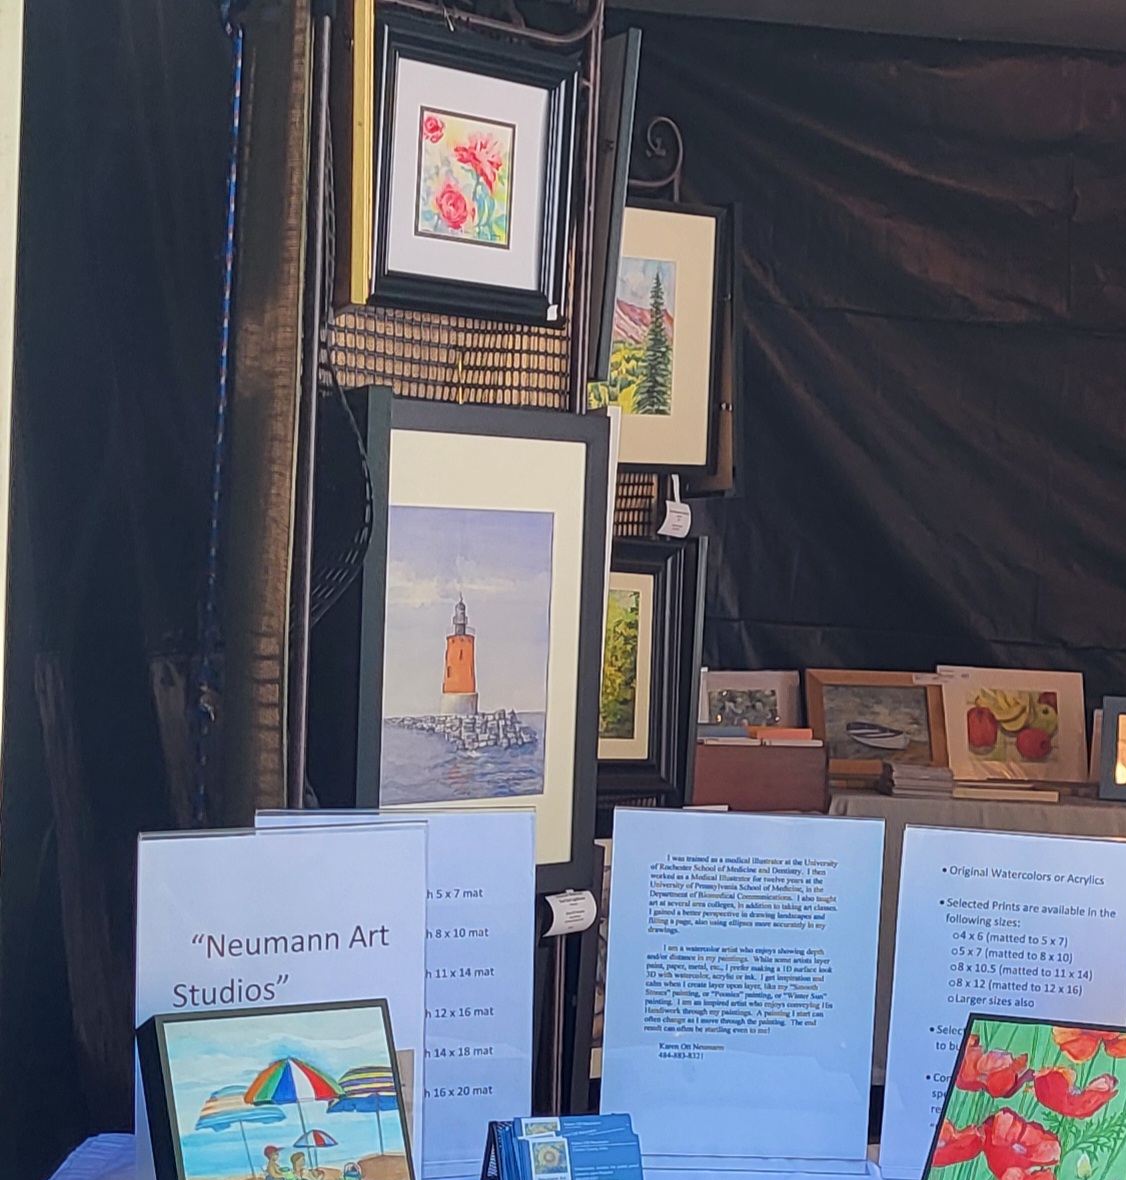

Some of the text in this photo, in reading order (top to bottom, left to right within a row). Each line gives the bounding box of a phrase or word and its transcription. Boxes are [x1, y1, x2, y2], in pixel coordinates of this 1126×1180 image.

[950, 866, 989, 878] Original
[991, 869, 1051, 881] Watercolors
[1067, 874, 1105, 886] Acrylics
[436, 889, 443, 899] 5
[445, 891, 452, 899] x
[454, 889, 460, 899] 7
[463, 889, 483, 898] mat
[947, 898, 1116, 918] Selected Prints are available in the
[946, 913, 1021, 928] following sizes:
[349, 925, 390, 948] Art
[435, 929, 442, 939] 8
[444, 931, 451, 939] x
[453, 928, 466, 938] 10
[468, 928, 489, 937] mat
[960, 930, 1068, 949] 4 x 6 (matted to 5 x 7)
[959, 946, 1073, 965] 5 x 7 (matted to 8 x 10)
[435, 969, 448, 979] 11
[450, 970, 457, 978] x
[459, 968, 472, 978] 14
[474, 968, 494, 977] mat
[957, 962, 964, 972] 8
[975, 964, 997, 974] 10.5
[999, 964, 1039, 977] (matted
[1041, 968, 1052, 977] to
[1055, 968, 1066, 978] 11
[1069, 971, 1075, 979] x
[1077, 970, 1093, 982] 14)
[956, 978, 963, 987] 8
[974, 979, 986, 989] 12
[988, 979, 1028, 991] (matted
[1030, 983, 1041, 992] to
[1044, 984, 1056, 993] 12
[1058, 986, 1064, 994] x
[1067, 985, 1082, 996] 16)
[955, 994, 1035, 1008] Larger sizes also
[434, 1008, 447, 1019] 12
[450, 1010, 456, 1018] x
[459, 1007, 472, 1017] 16
[474, 1007, 494, 1016] mat
[937, 1025, 964, 1035] Selec
[433, 1048, 447, 1058] 14
[449, 1050, 456, 1058] x
[458, 1047, 471, 1057] 18
[473, 1047, 493, 1056] mat
[936, 1042, 946, 1050] to
[433, 1088, 447, 1098] 16
[448, 1089, 455, 1097] x
[457, 1086, 470, 1096] 20
[473, 1086, 493, 1095] mat
